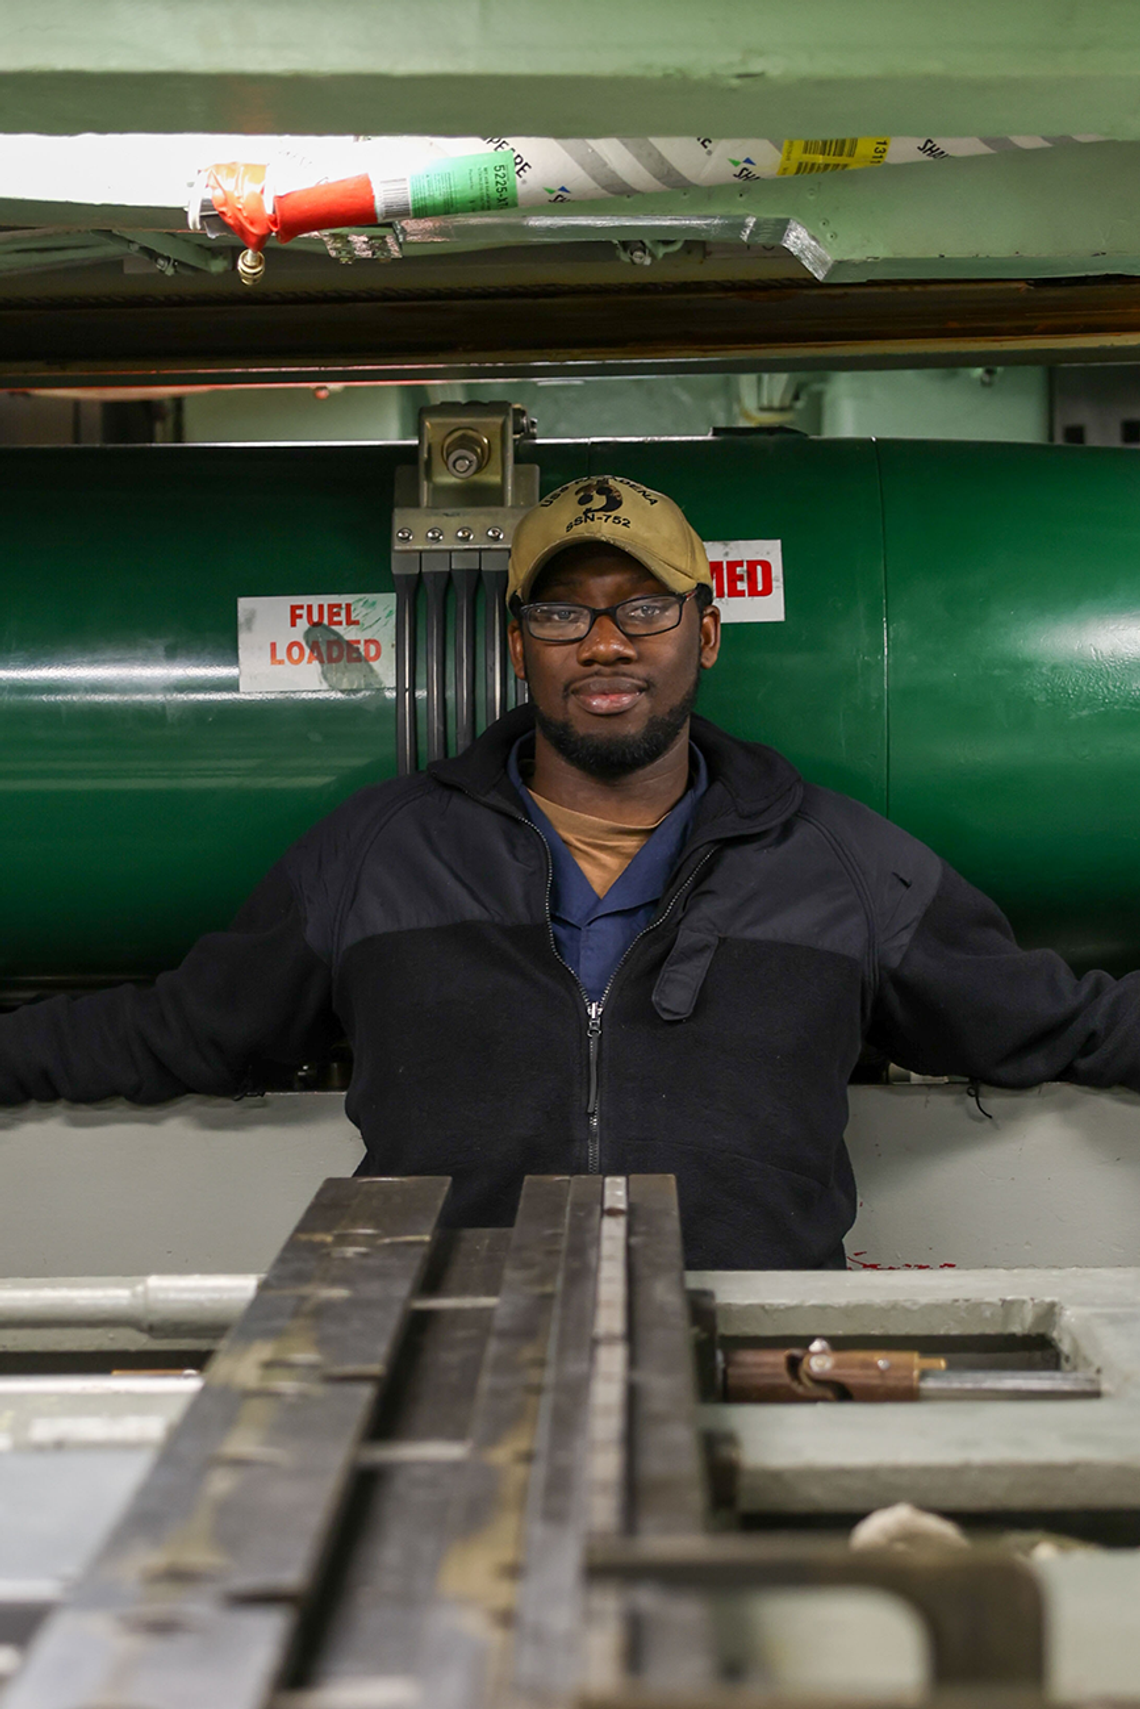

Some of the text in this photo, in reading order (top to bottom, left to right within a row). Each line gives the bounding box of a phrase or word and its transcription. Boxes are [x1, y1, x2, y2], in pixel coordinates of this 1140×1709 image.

[565, 513, 631, 533] SSN-752
[289, 602, 360, 628] FUEL
[269, 638, 382, 665] LOADED
